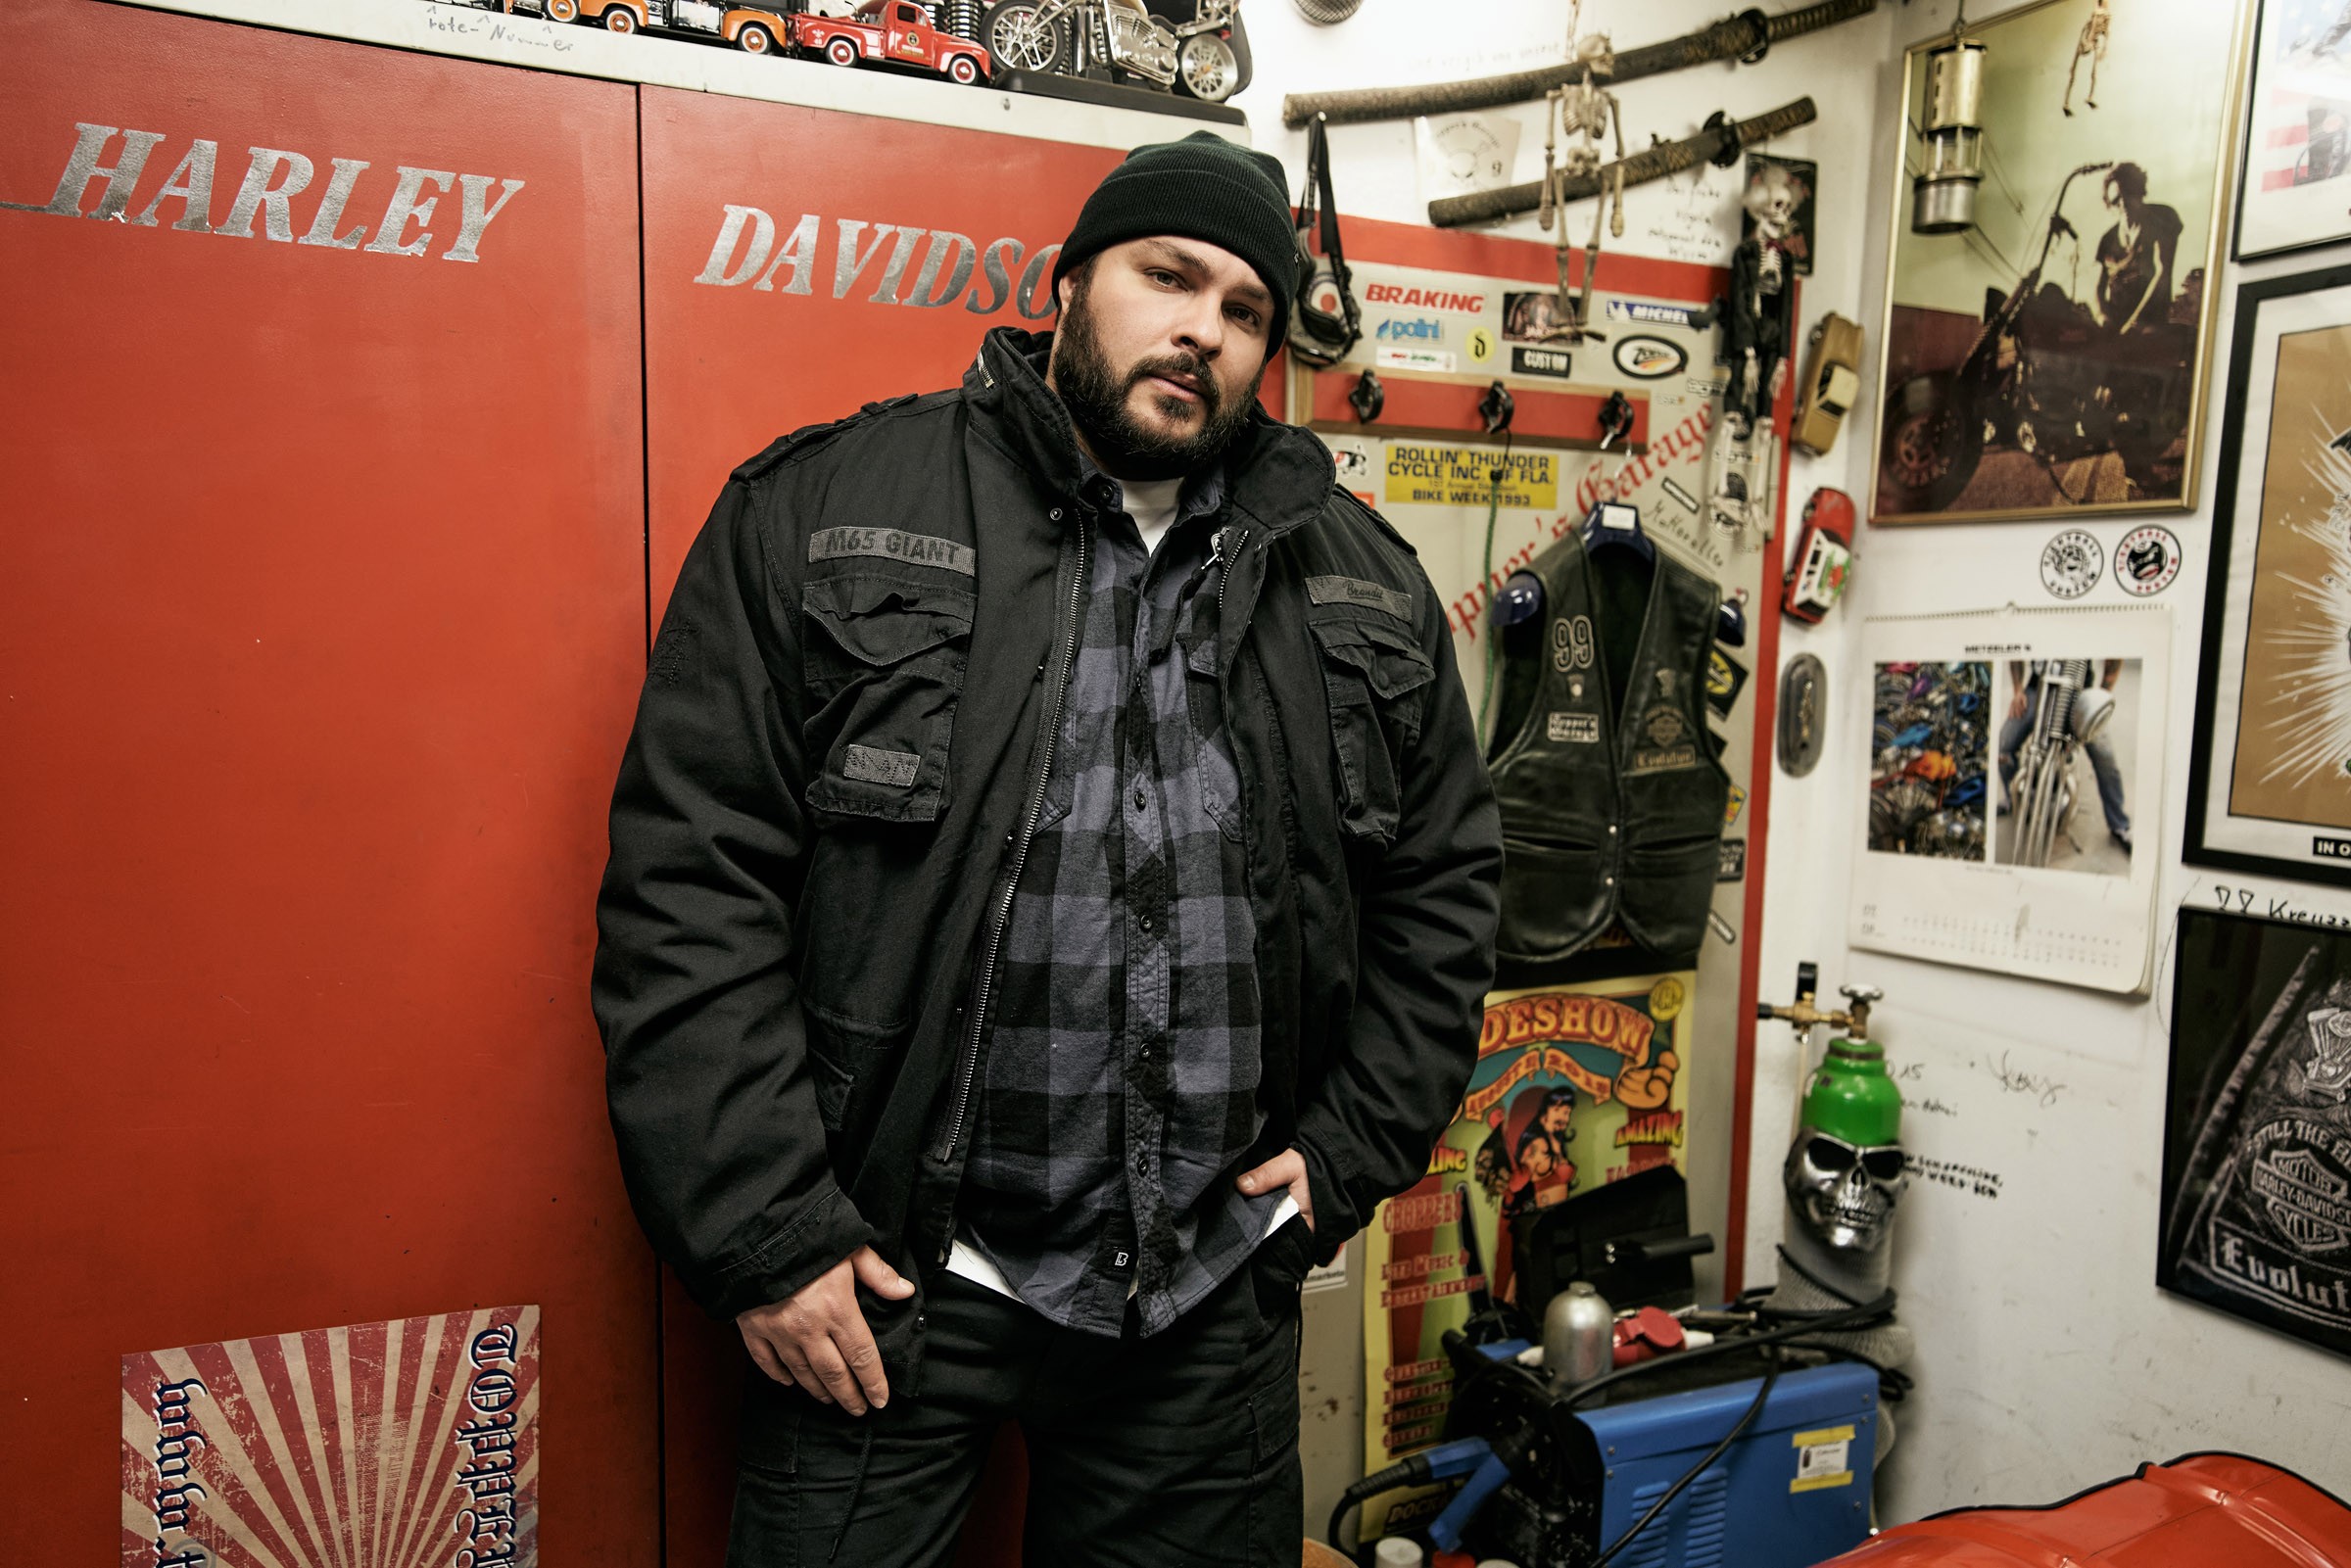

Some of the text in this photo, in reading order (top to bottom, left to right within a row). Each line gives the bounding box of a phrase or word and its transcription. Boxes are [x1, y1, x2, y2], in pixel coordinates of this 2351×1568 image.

[47, 121, 525, 263] HARLEY
[694, 204, 1062, 321] DAVIDSO
[1366, 283, 1484, 313] BRAKING
[1632, 305, 1689, 325] MICHEL
[1388, 461, 1444, 478] CYCLE
[1451, 465, 1486, 482] INC.
[1520, 469, 1554, 485] FLA.
[1396, 447, 1550, 469] ROLLIN' THUNDER
[1413, 489, 1531, 506] BIKE WEEK 1993
[825, 529, 960, 565] M65 GIANT
[1553, 614, 1595, 673] 99
[2317, 840, 2334, 855] IN
[1479, 997, 1650, 1057] DESHOW
[1615, 1109, 1684, 1148] AMAZING
[2294, 1119, 2330, 1151] THE
[1427, 1147, 1466, 1174] LING
[2256, 1167, 2351, 1226] HARLEY-DAVIDSO
[2274, 1204, 2336, 1245] CYCLES
[2220, 1231, 2350, 1313] Evolut
[153, 1377, 208, 1568] www.t
